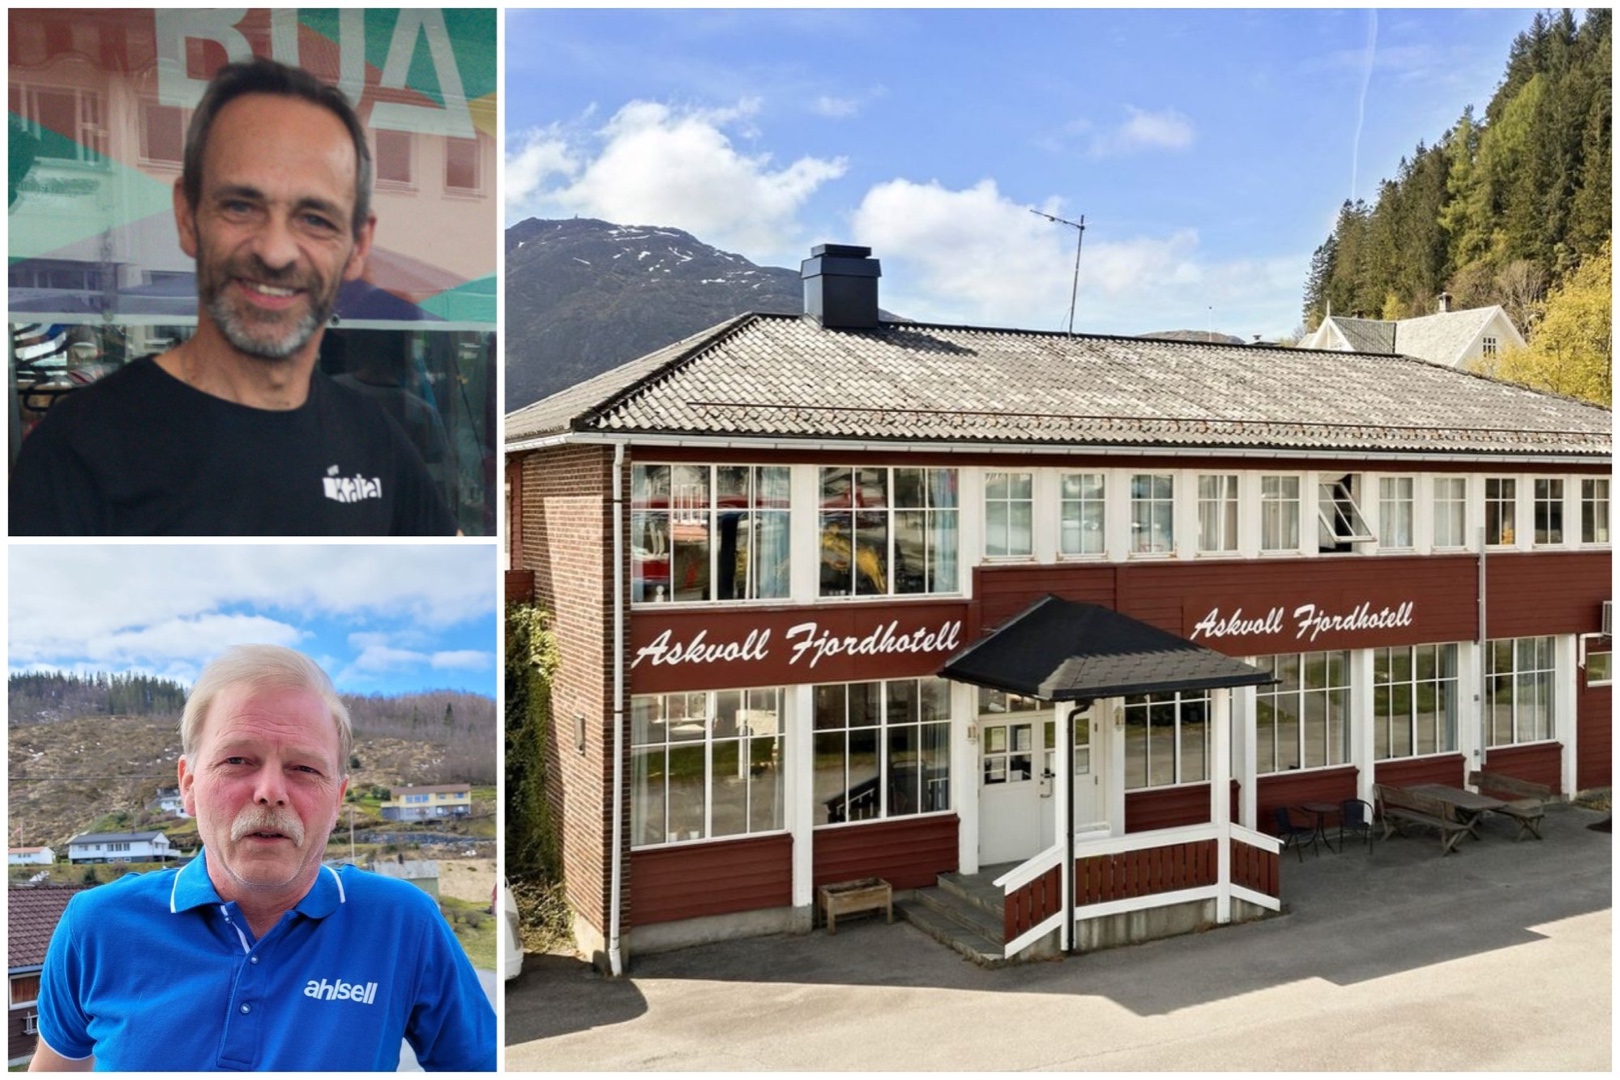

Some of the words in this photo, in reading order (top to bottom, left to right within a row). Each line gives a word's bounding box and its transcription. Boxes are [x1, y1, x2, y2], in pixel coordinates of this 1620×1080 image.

[1190, 606, 1284, 641] Askvoll
[1293, 601, 1413, 642] Fjordhotell
[630, 627, 771, 669] Askvoll
[786, 620, 962, 669] Fjordhotell
[304, 978, 378, 1005] ahlsell
